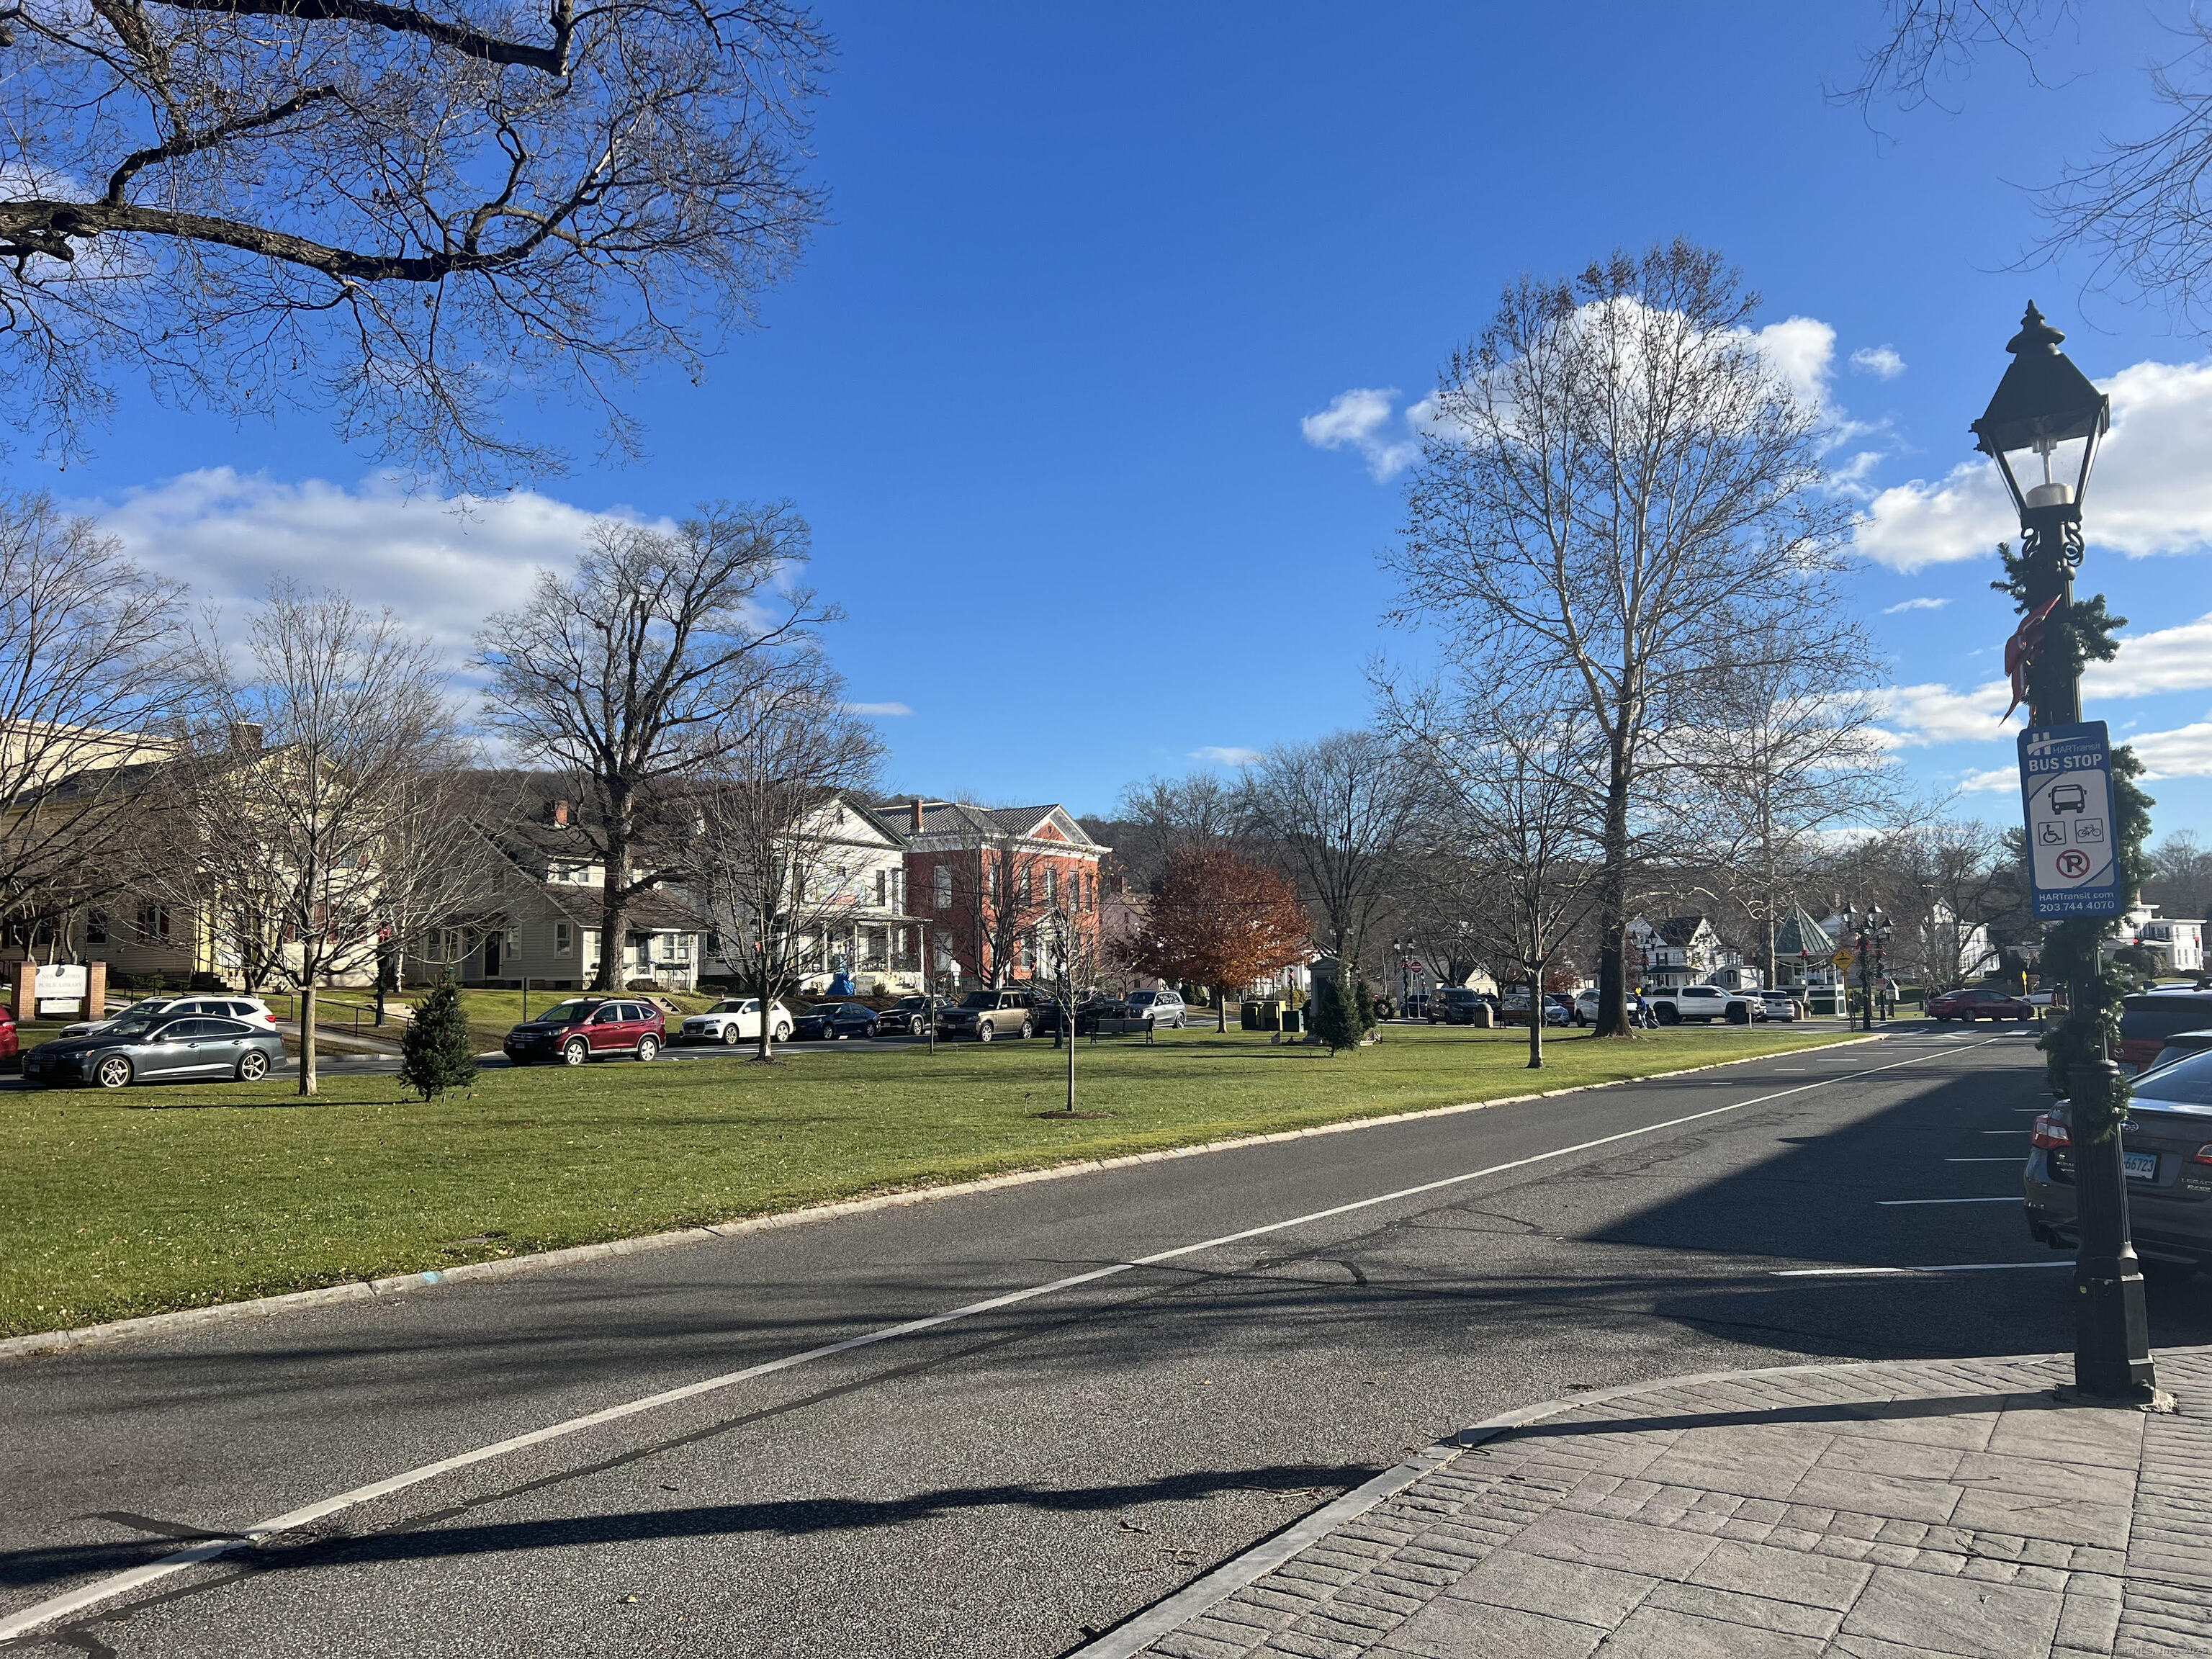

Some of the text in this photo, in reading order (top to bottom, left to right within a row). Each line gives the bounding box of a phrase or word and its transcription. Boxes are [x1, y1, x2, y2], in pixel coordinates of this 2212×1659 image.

[2053, 743, 2101, 754] HARTransit
[2028, 753, 2103, 772] BUS STOP
